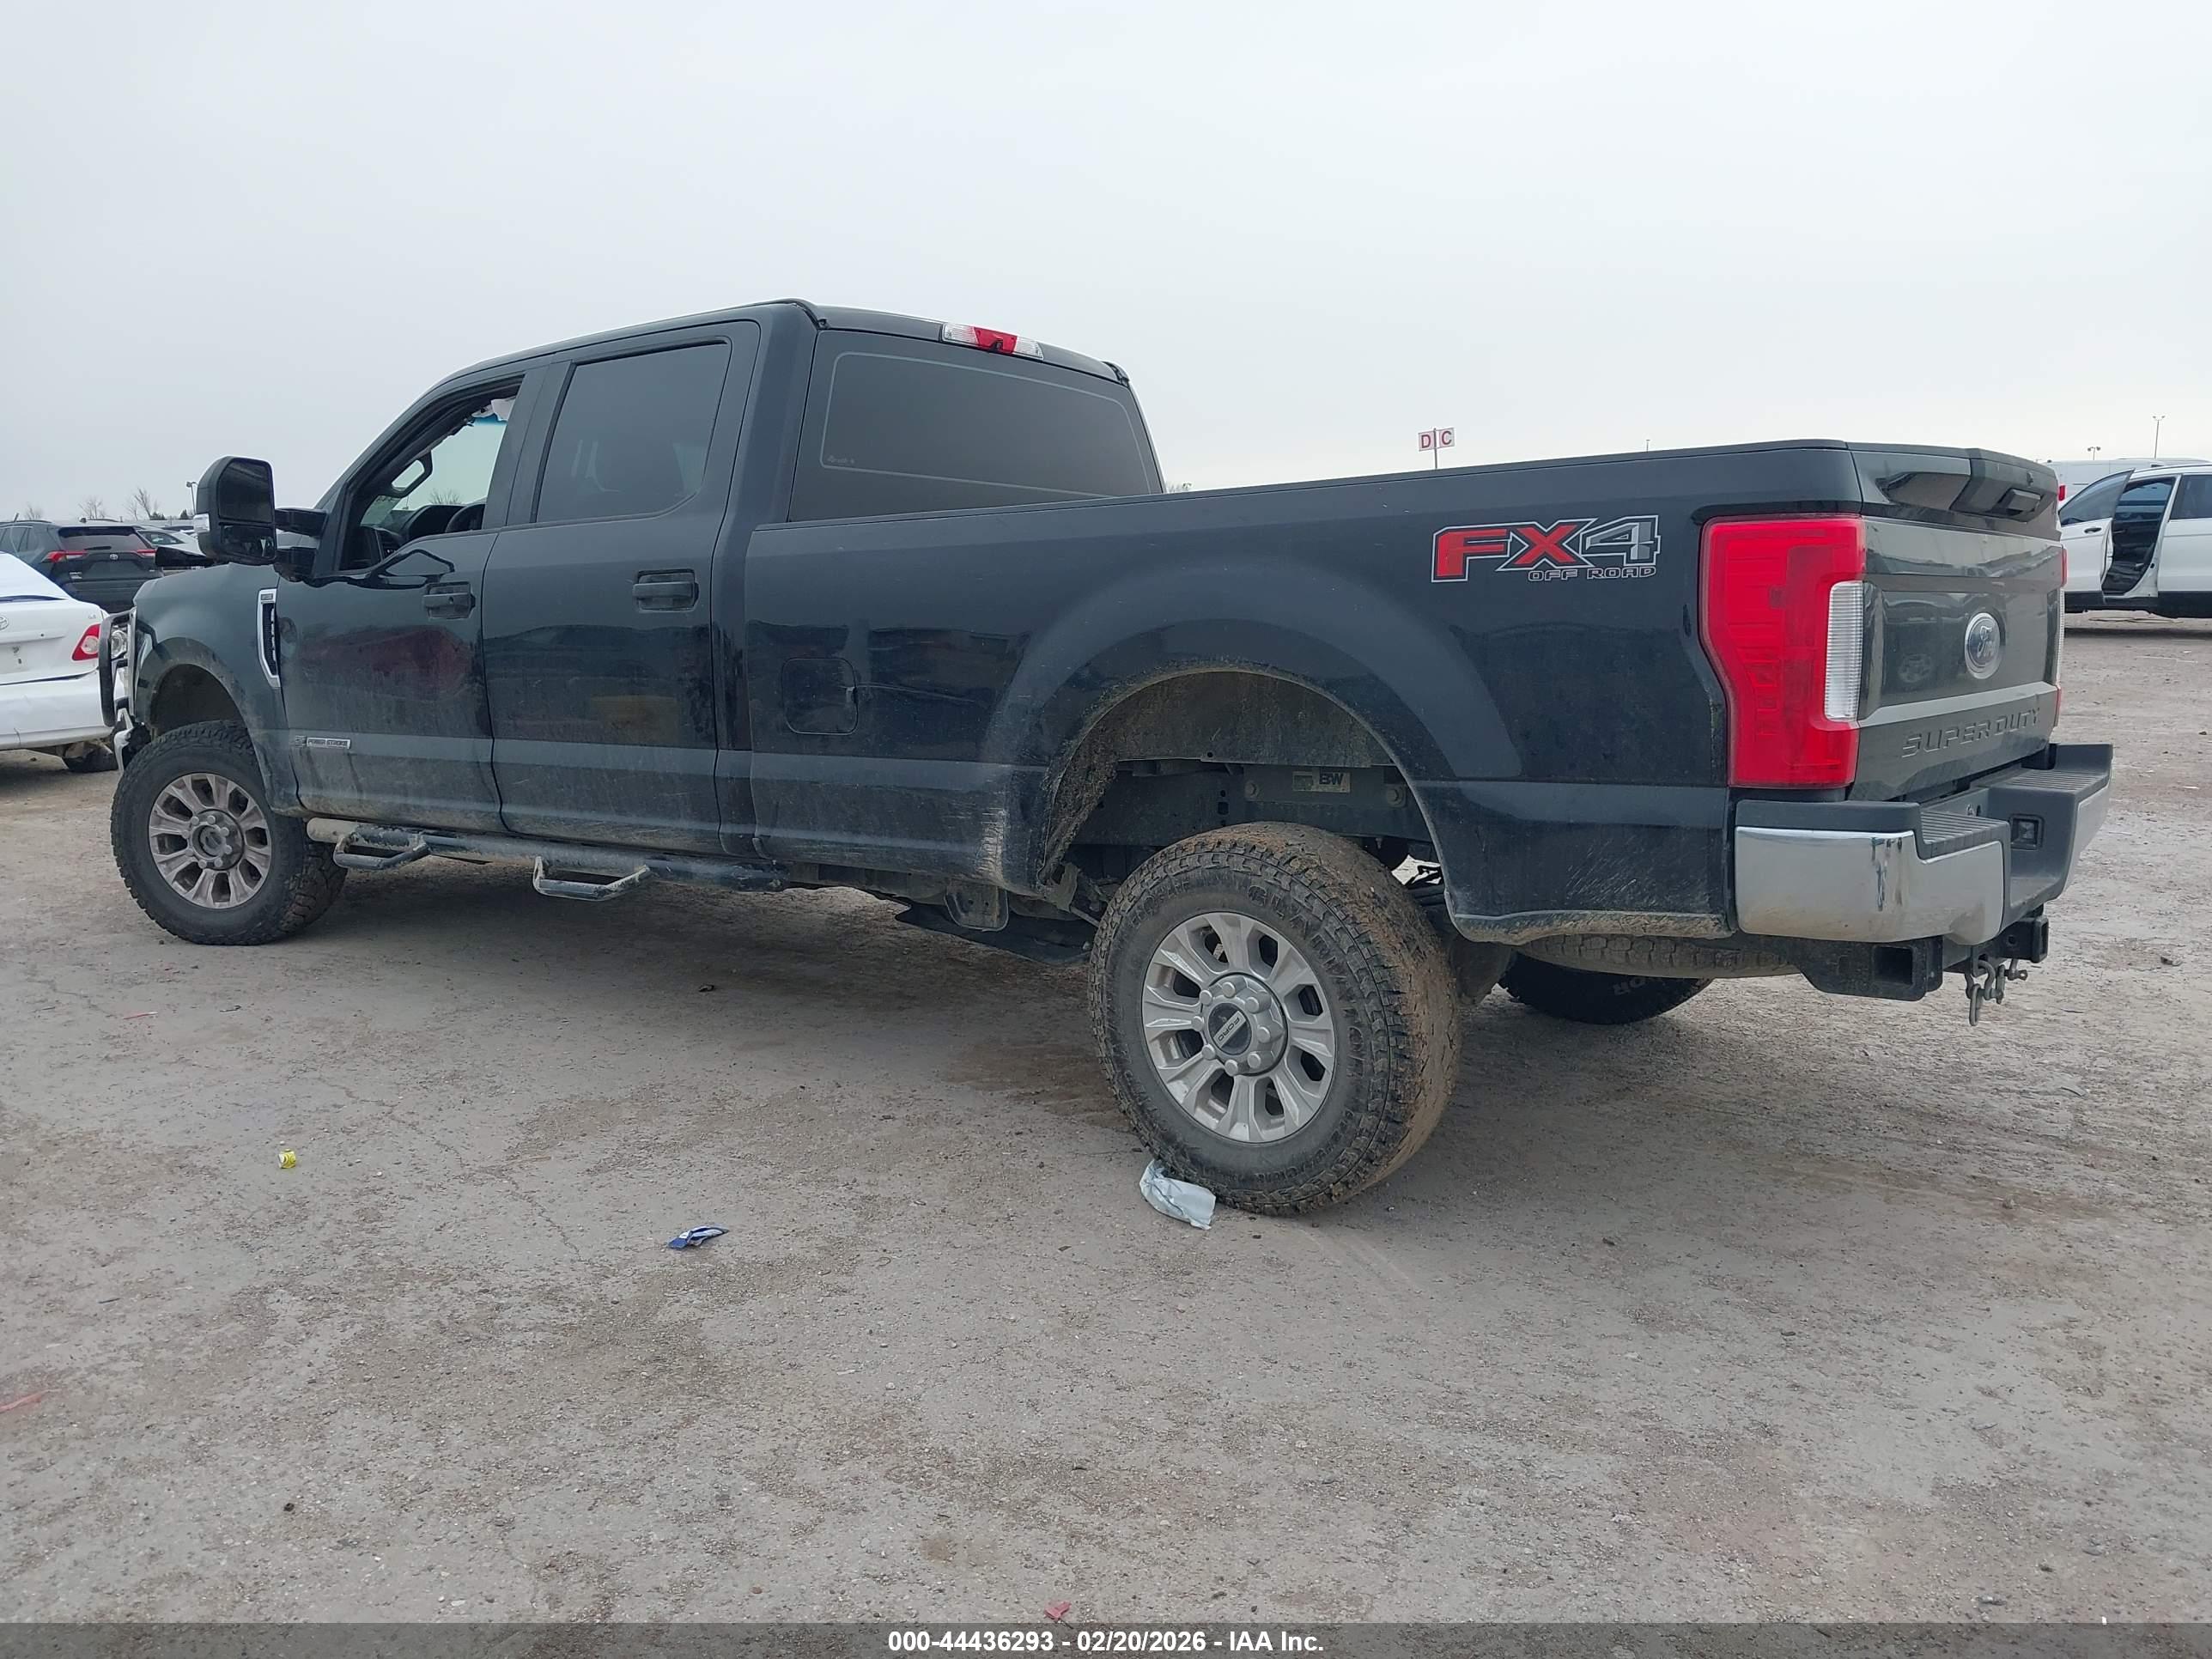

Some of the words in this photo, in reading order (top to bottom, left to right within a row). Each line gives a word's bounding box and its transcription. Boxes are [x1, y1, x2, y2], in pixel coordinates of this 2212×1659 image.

[1421, 434, 1431, 448] D
[1442, 430, 1452, 445] C
[1431, 515, 1661, 582] FX4
[1528, 568, 1578, 581] OFF
[1587, 566, 1657, 580] ROAD
[1901, 720, 1991, 758] SUPER
[1994, 707, 2040, 736] DUTY
[1218, 1017, 1240, 1042] FORD
